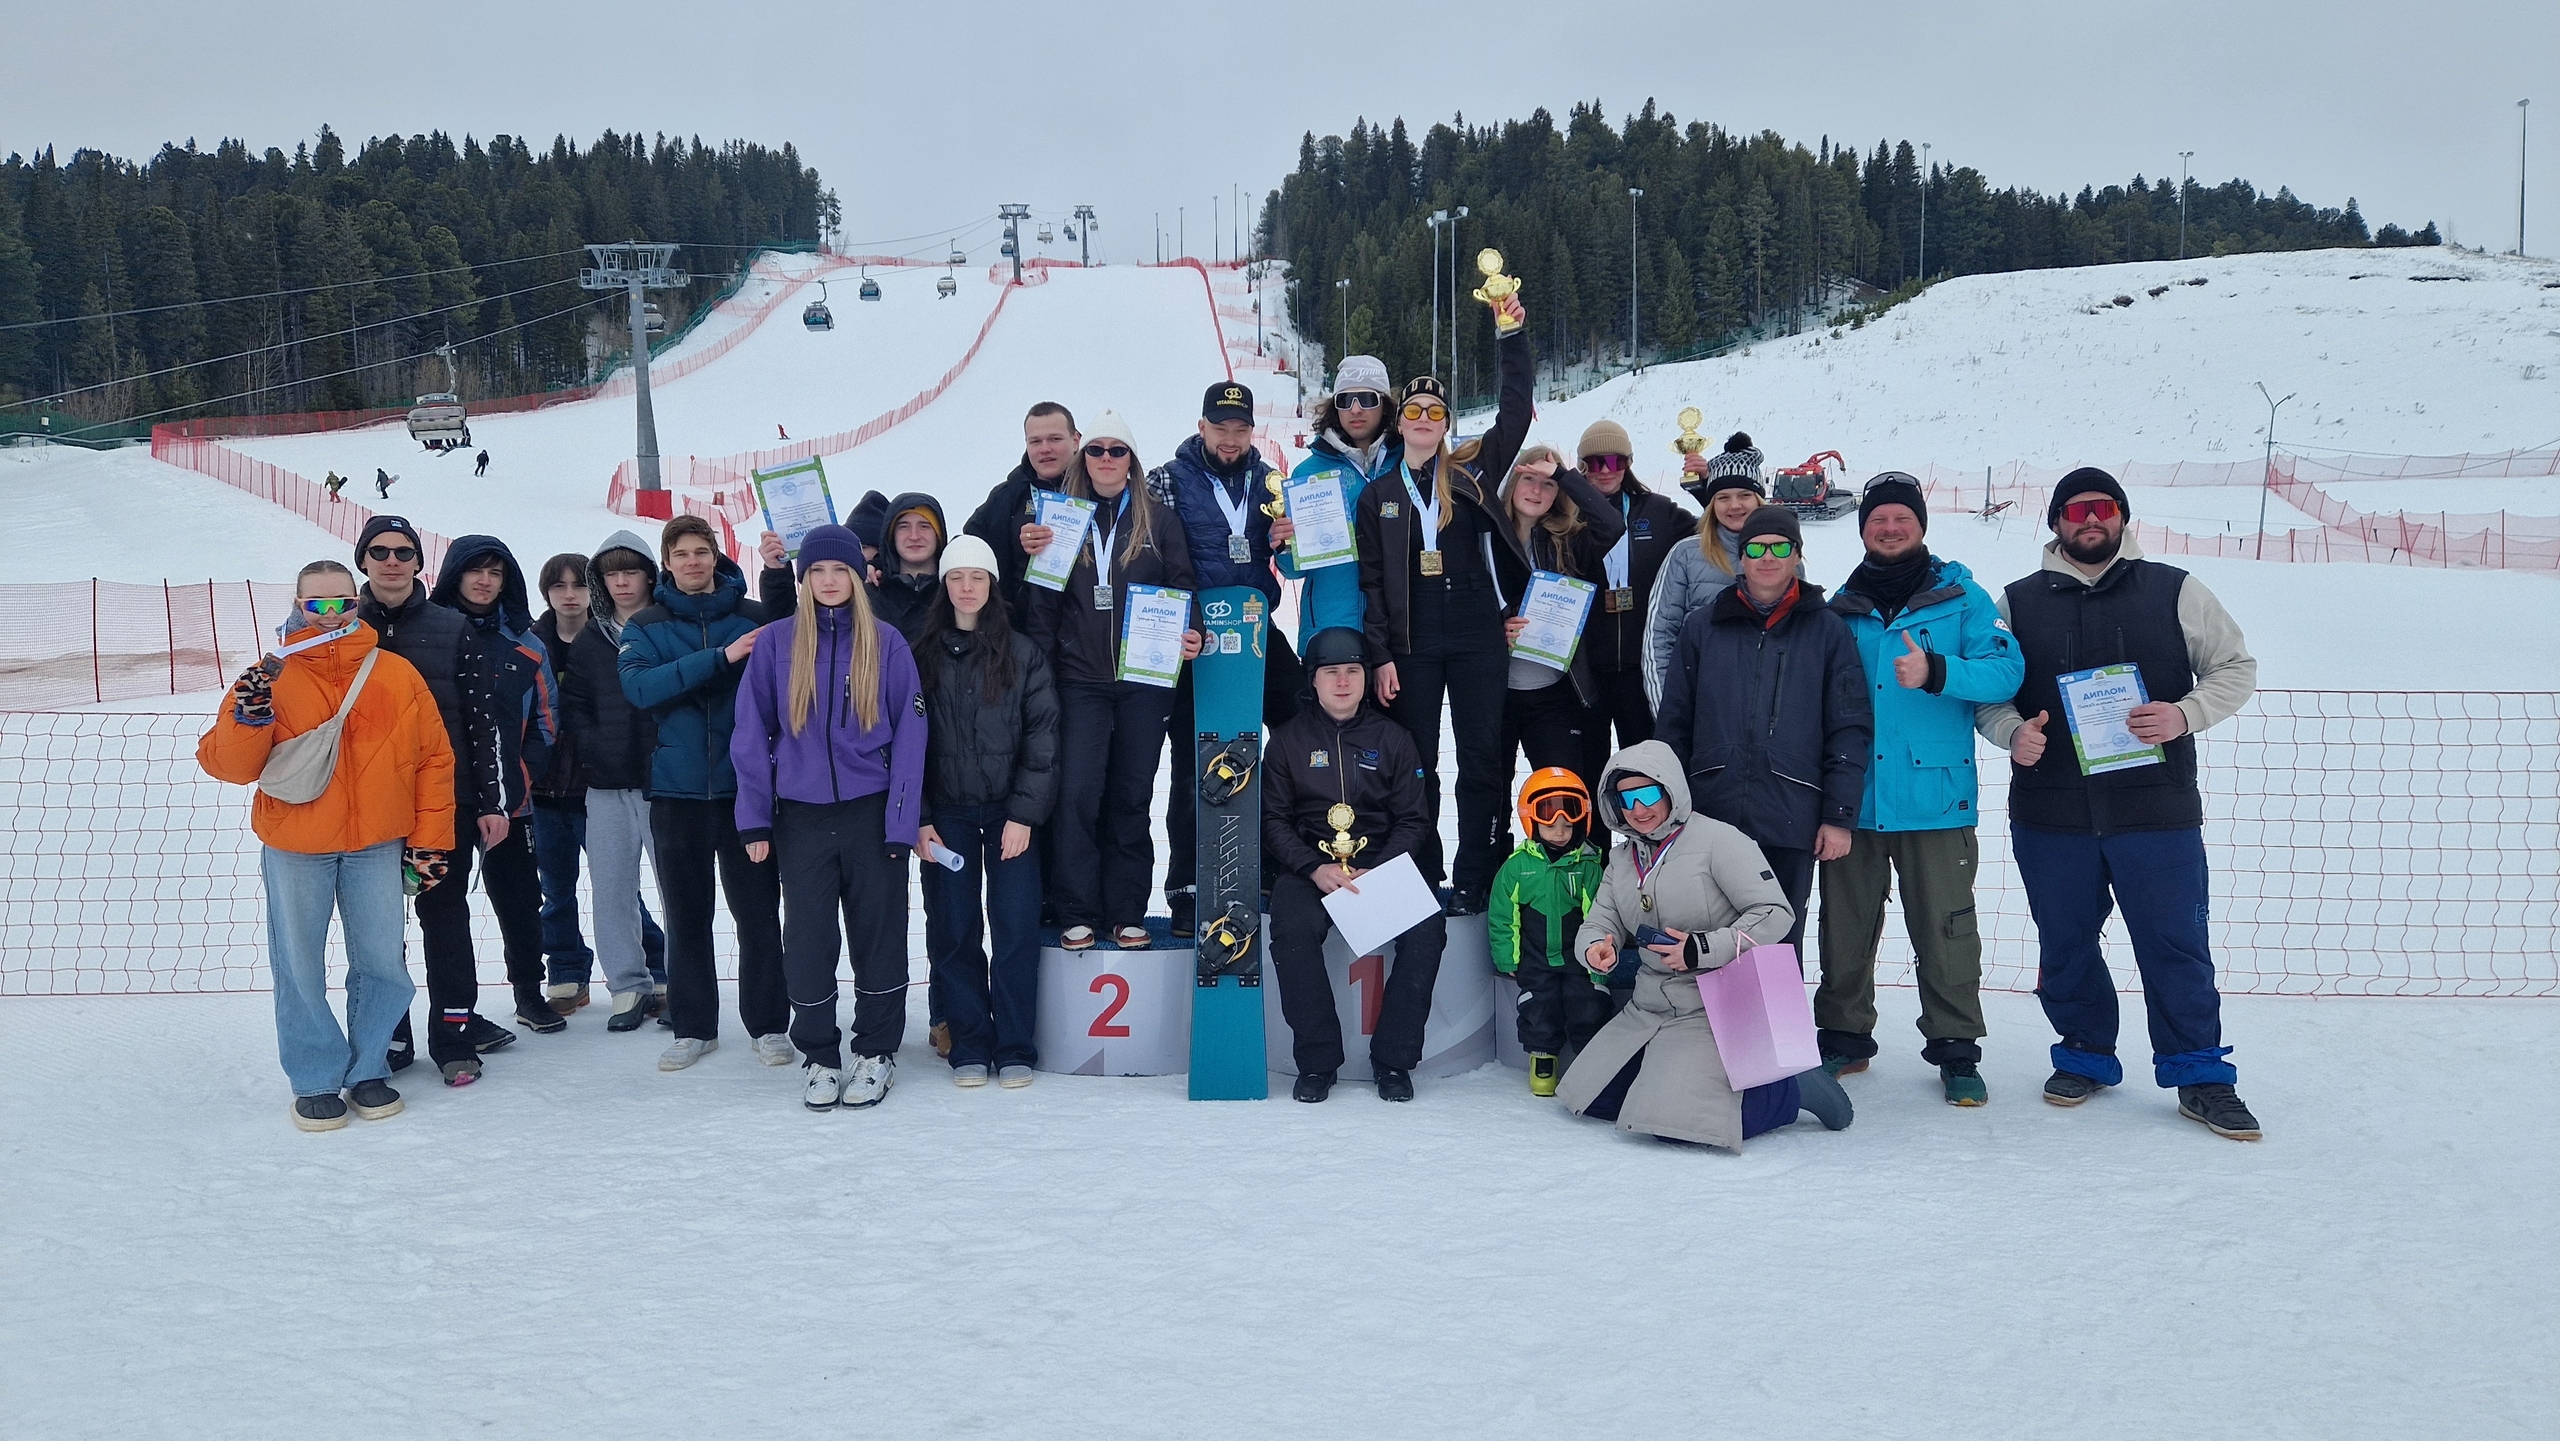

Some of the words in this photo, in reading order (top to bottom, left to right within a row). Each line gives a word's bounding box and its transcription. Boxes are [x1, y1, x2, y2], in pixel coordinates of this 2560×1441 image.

[1299, 490, 1333, 503] ДИПЛОМ
[1051, 513, 1080, 525] ДИПЛОМ
[1541, 591, 1577, 605] ДИПЛОМ
[1142, 606, 1176, 617] ДИПЛОМ
[2083, 686, 2127, 701] ДИПЛОМ
[1220, 815, 1240, 896] ALLFLEX
[1349, 955, 1384, 1035] 1
[1088, 974, 1130, 1037] 2
